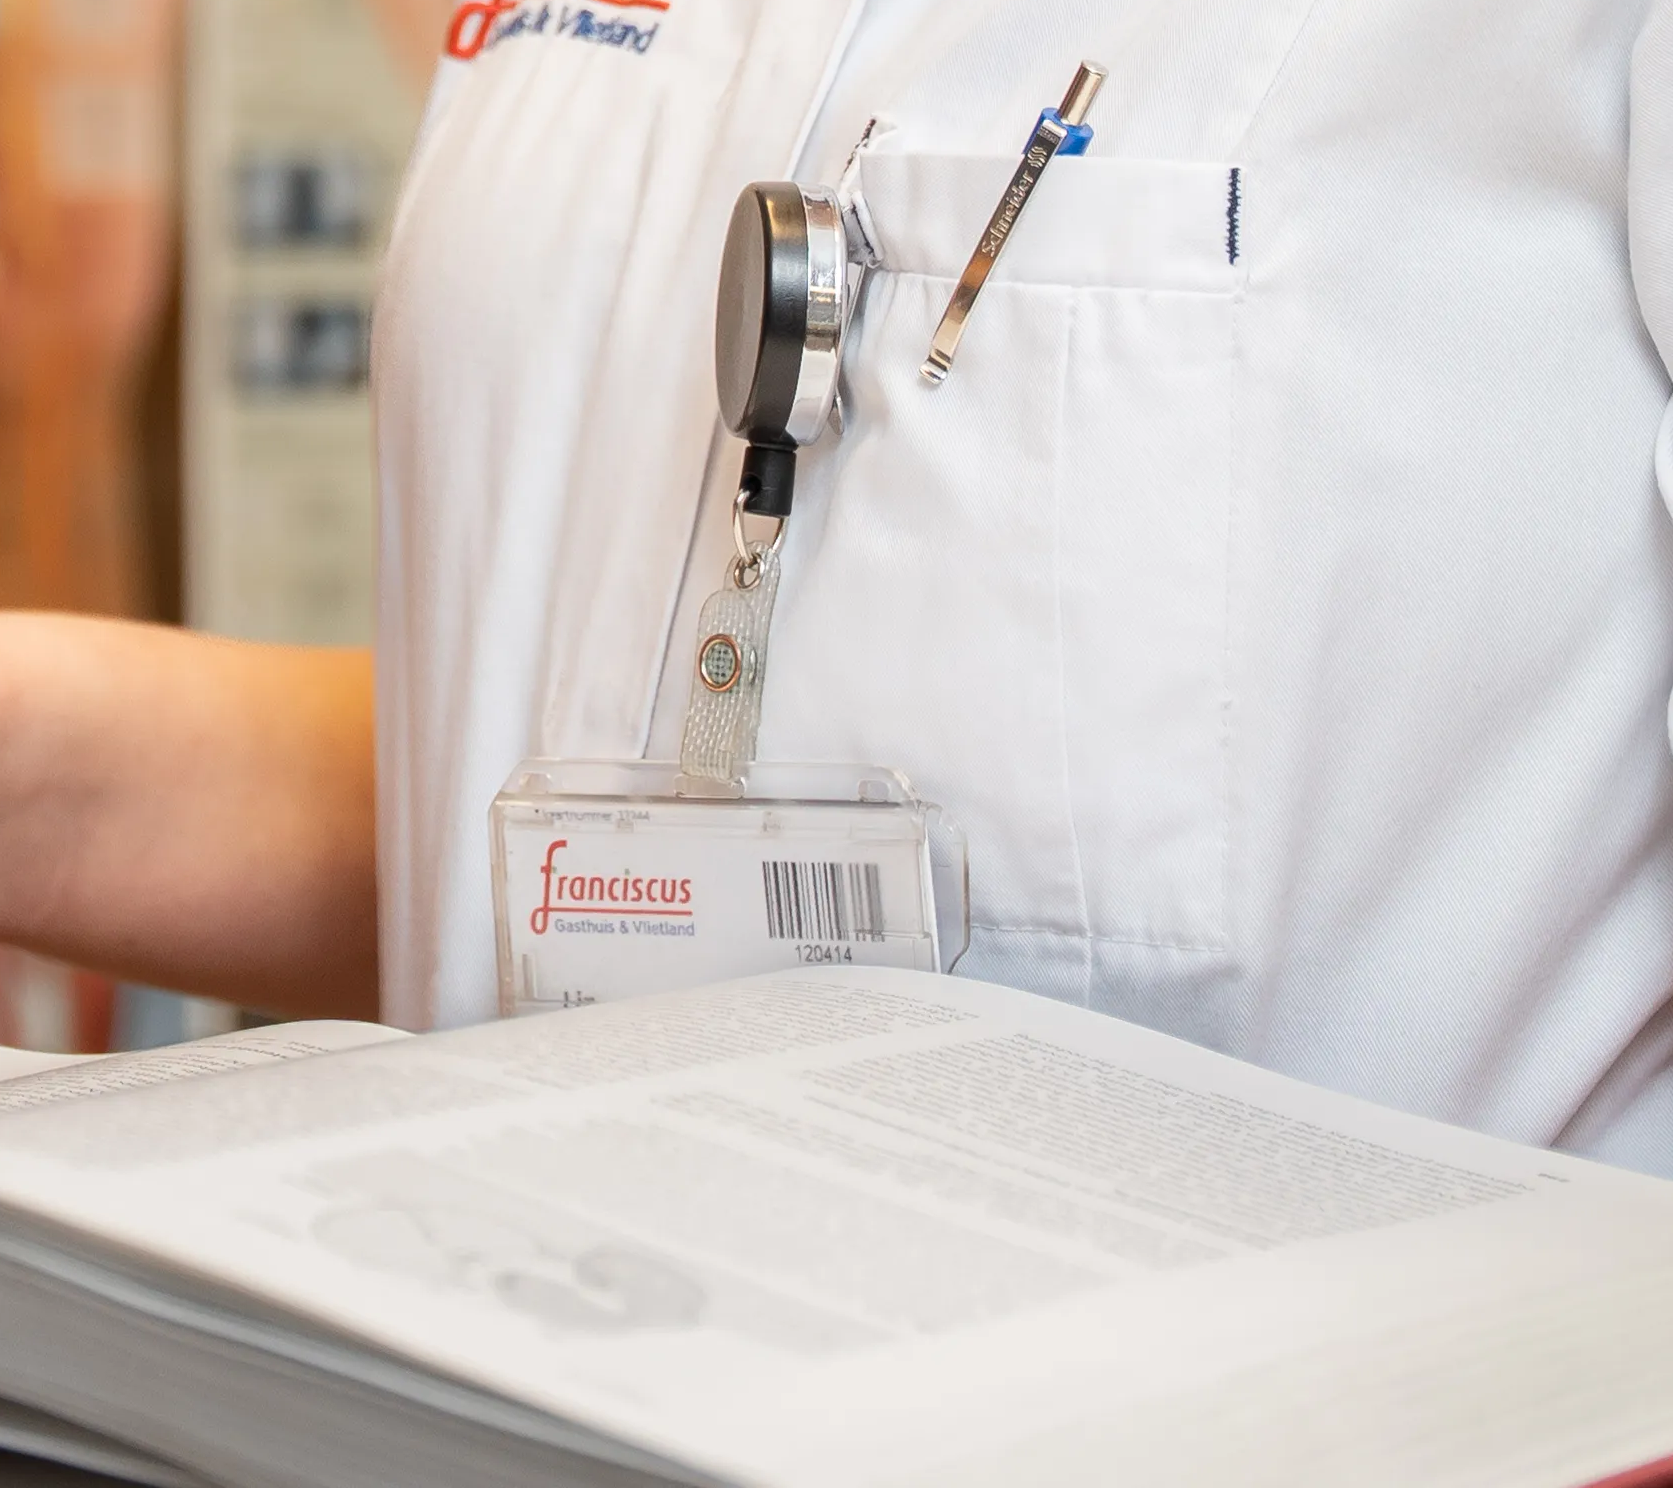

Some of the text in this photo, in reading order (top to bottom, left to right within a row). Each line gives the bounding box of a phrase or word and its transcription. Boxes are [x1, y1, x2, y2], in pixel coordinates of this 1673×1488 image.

[981, 170, 1034, 258] Schneider
[530, 839, 693, 935] franciscus
[554, 918, 696, 937] Gasthuis & Vlietland
[795, 945, 853, 964] 120414
